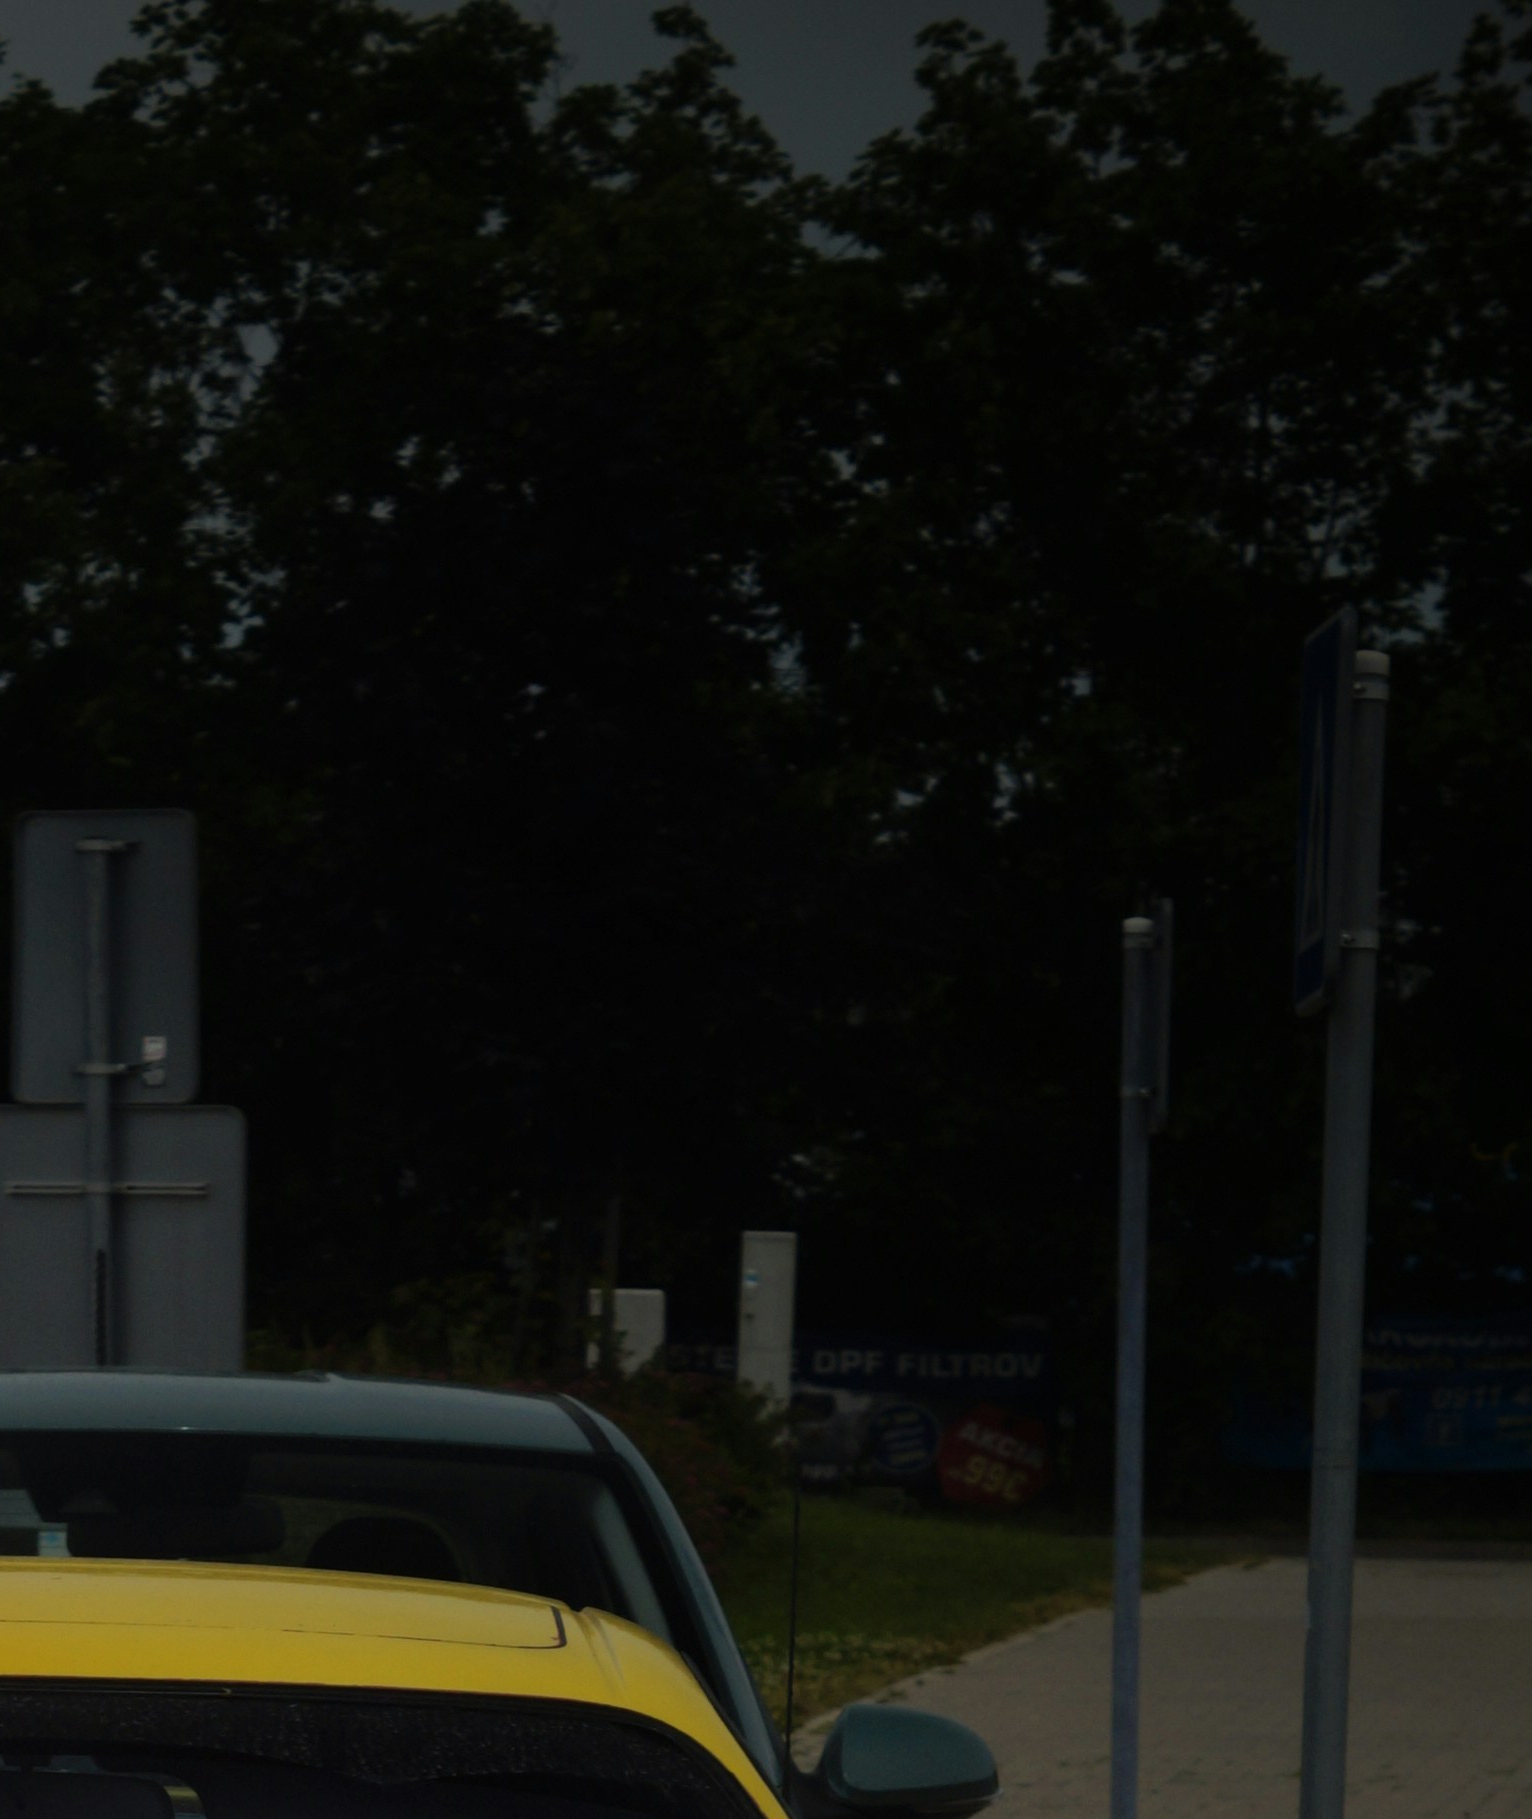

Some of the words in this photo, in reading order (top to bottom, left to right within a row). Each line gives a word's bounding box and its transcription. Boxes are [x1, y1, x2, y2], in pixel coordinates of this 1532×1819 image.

[812, 1349, 884, 1376] DPF
[896, 1352, 1044, 1380] FILTROV
[957, 1420, 1047, 1469] AKCIA
